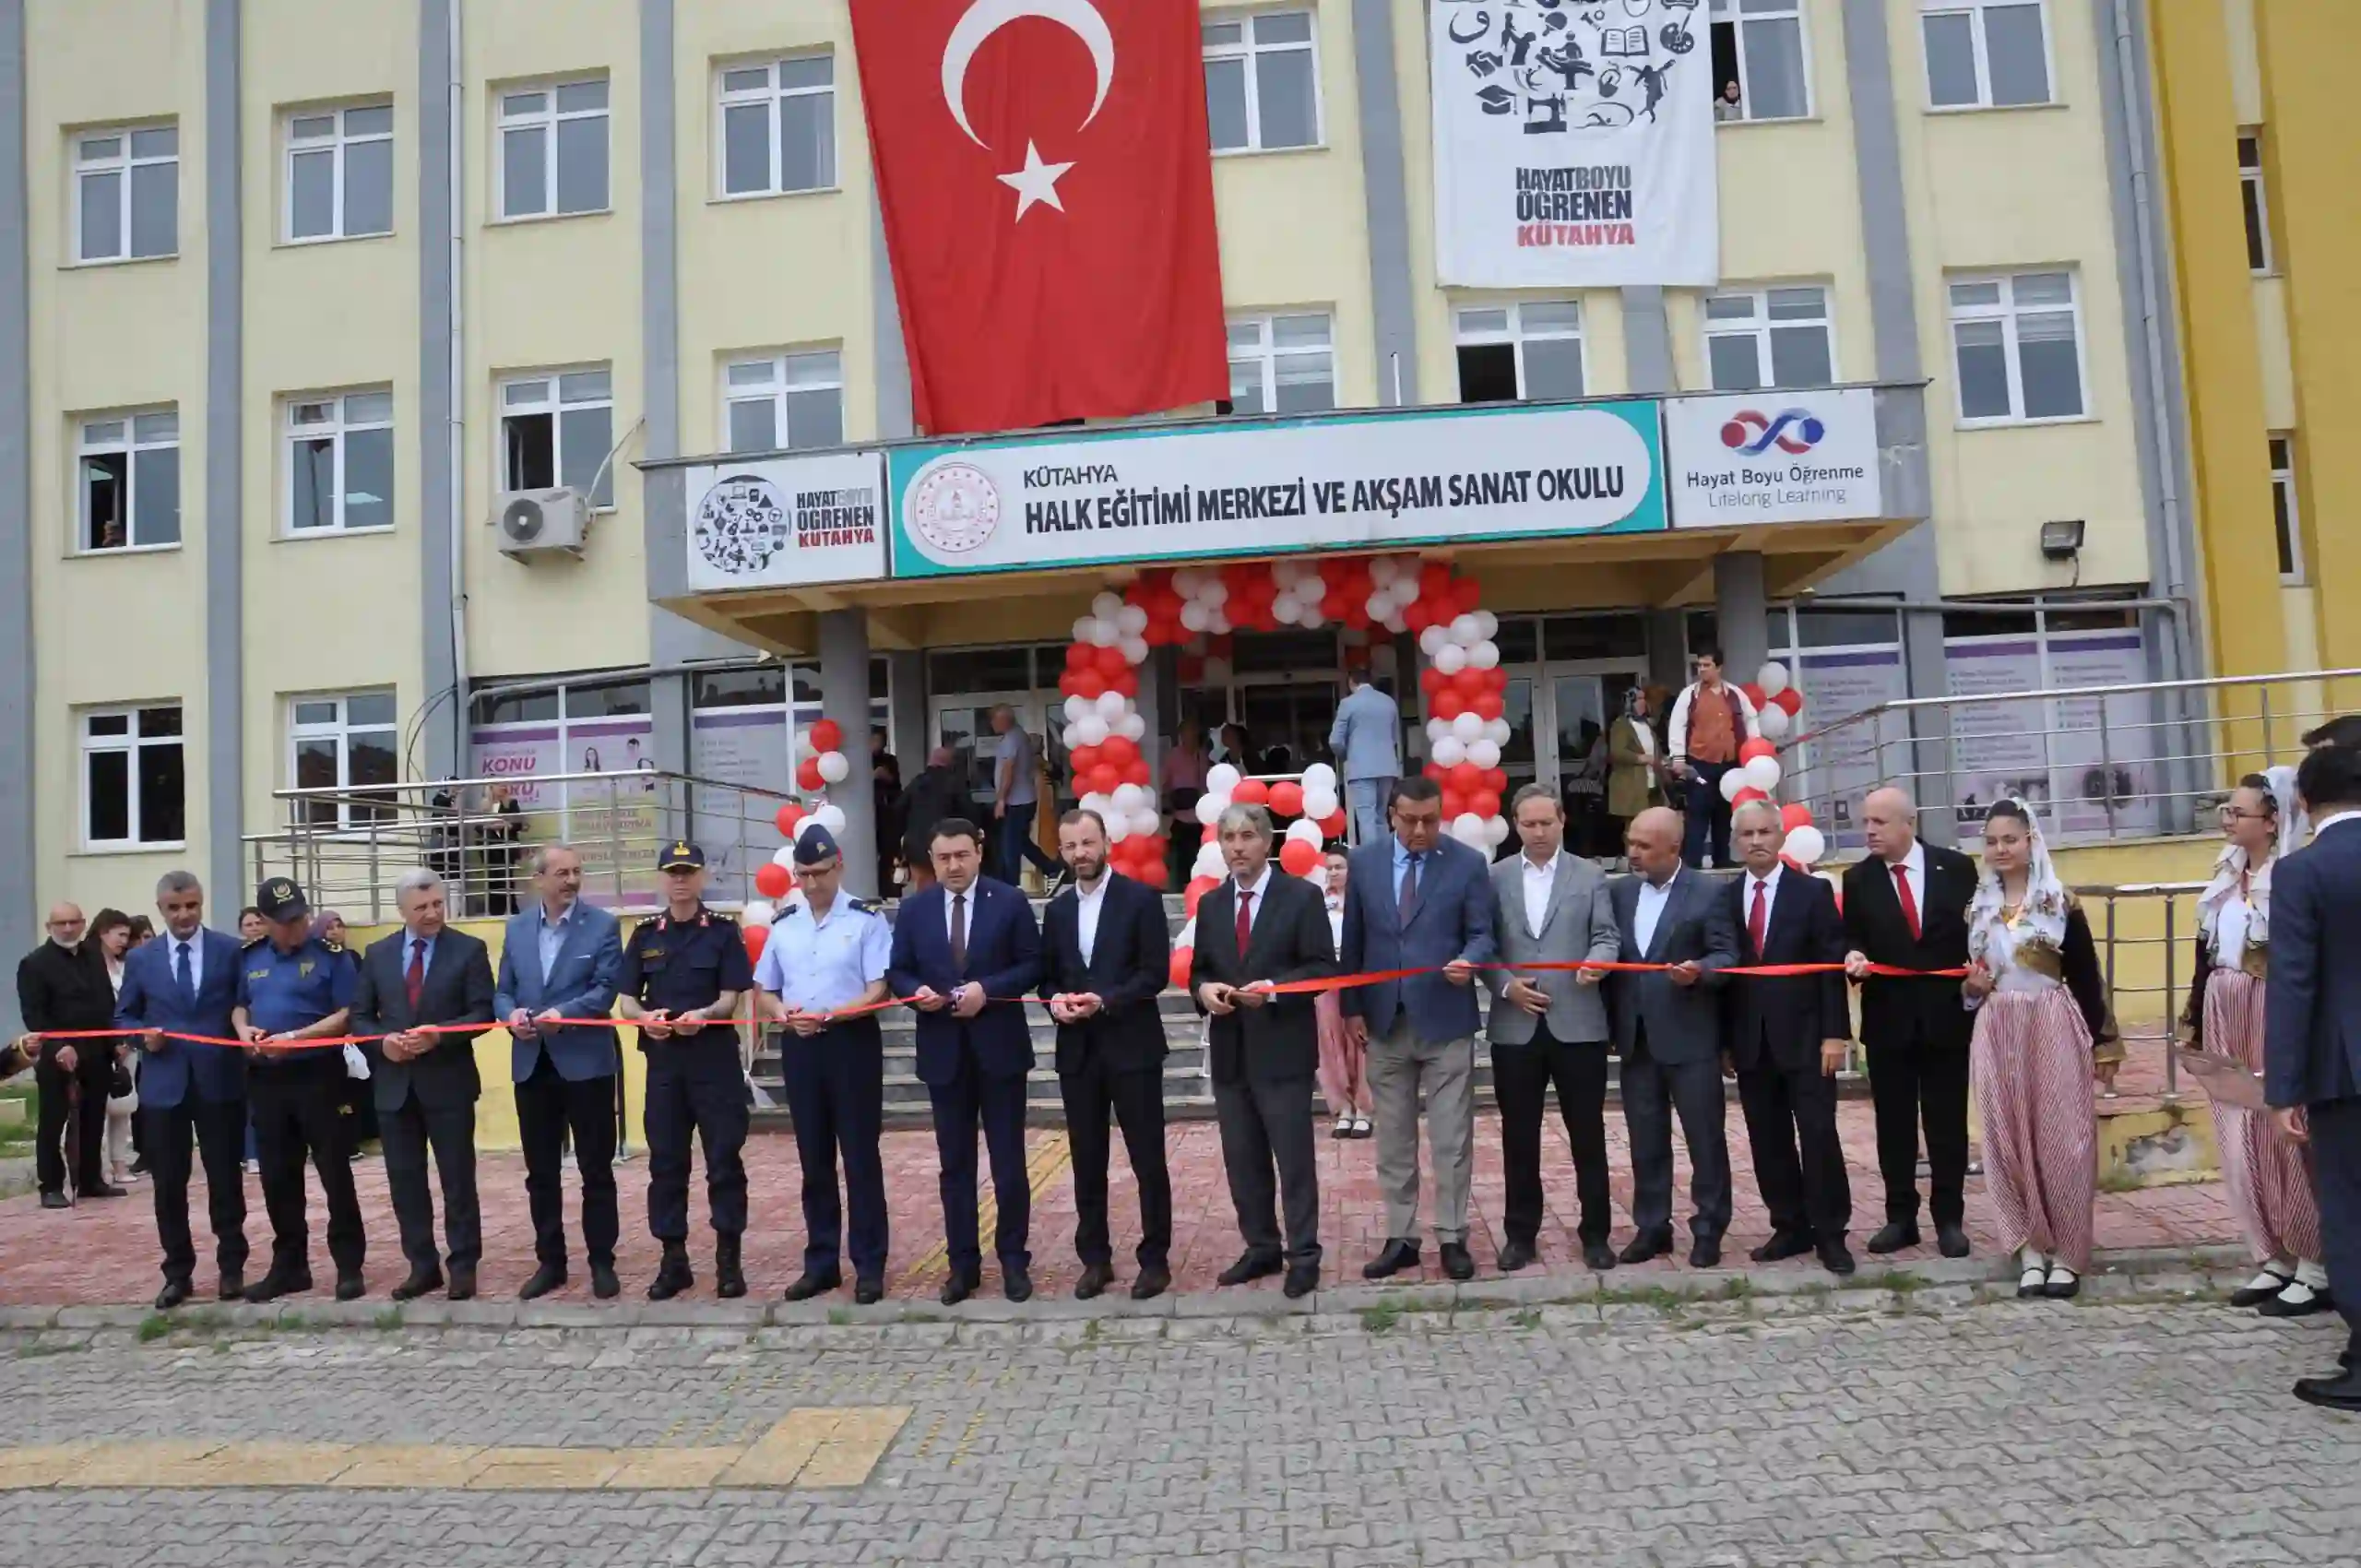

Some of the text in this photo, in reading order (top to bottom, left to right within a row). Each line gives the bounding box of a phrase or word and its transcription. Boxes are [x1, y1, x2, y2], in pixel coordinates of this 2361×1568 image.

[1024, 464, 1118, 489] KÜTAHYA
[1687, 462, 1864, 489] Hayat Boyu Öğrenme
[1026, 498, 1093, 534] HALK
[1097, 484, 1191, 529] EĞİTİMİ
[1198, 476, 1306, 522] MERKEZİ
[1312, 481, 1347, 514] VE
[1352, 476, 1443, 518] AKŞAM
[1449, 470, 1532, 506] SANAT
[1536, 465, 1624, 501] OKULU
[1777, 488, 1846, 505] Learning
[482, 756, 536, 774] KONU
